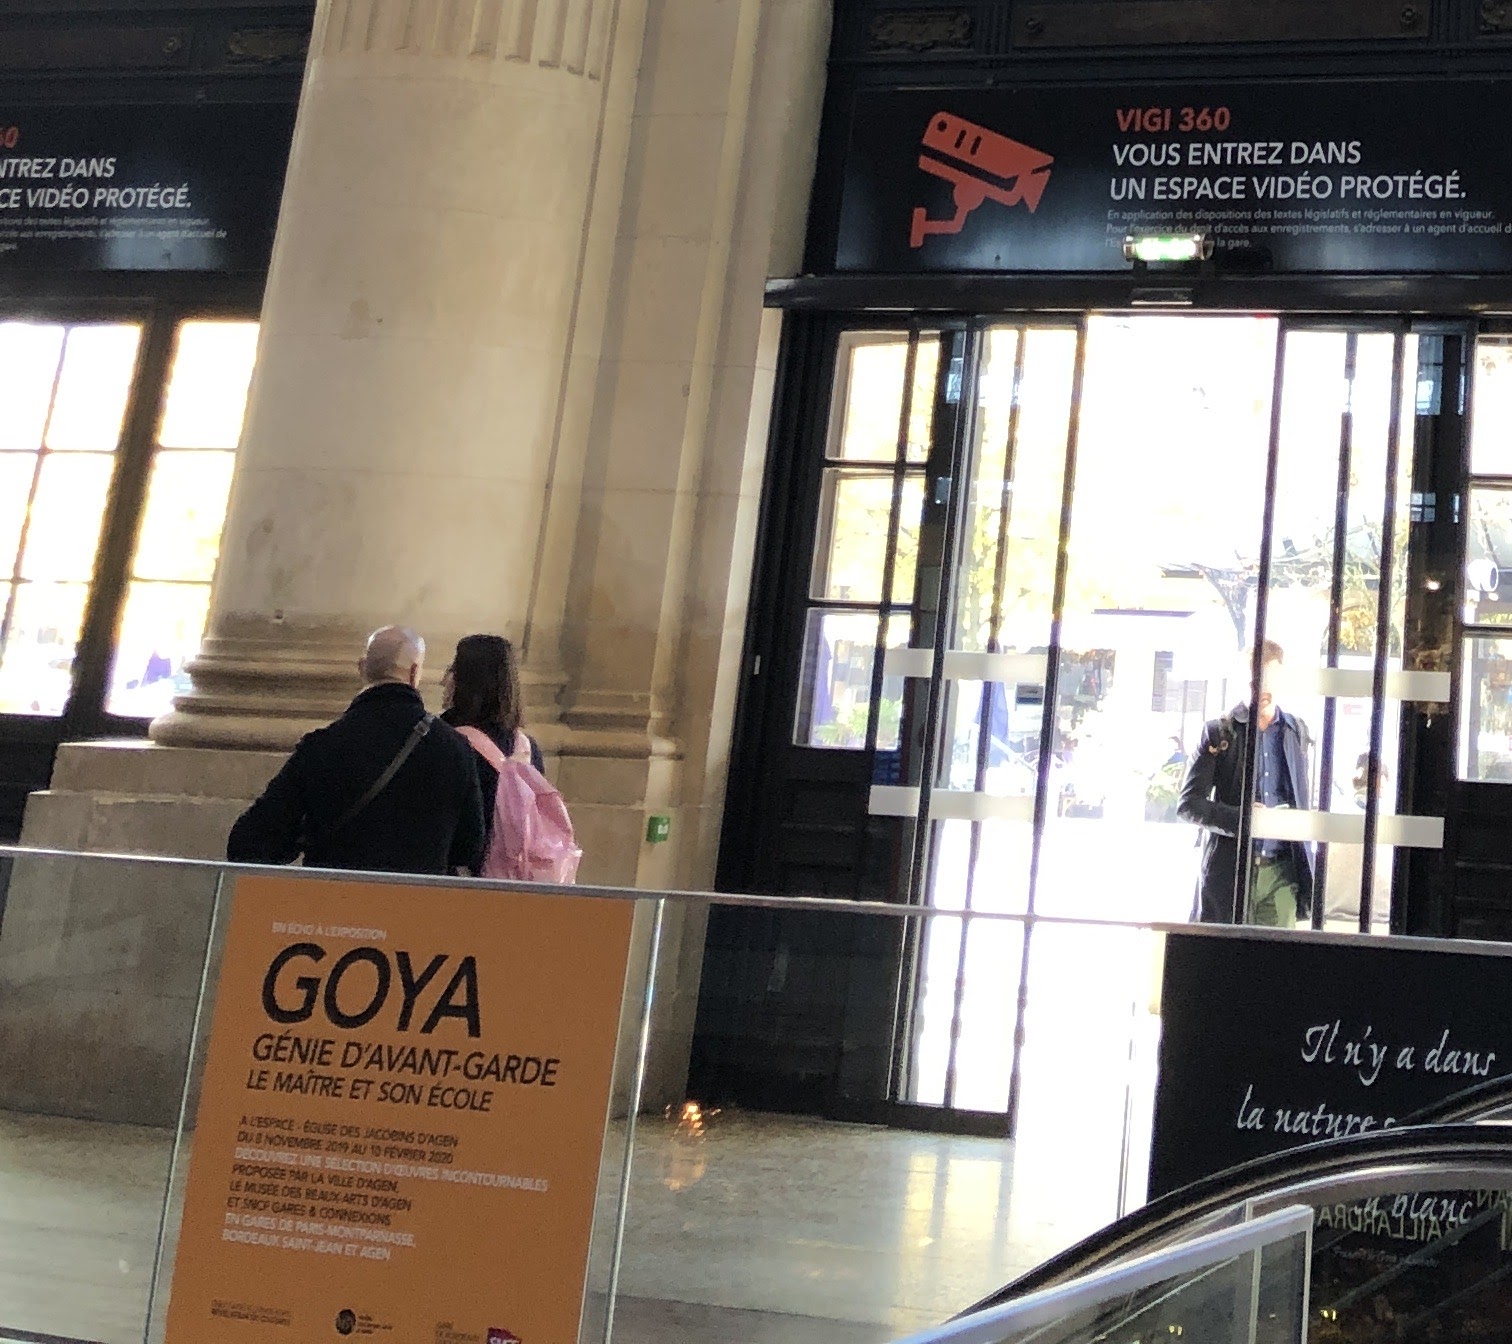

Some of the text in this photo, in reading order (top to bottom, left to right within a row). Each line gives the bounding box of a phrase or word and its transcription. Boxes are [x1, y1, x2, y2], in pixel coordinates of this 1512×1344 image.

[1116, 107, 1231, 132] VIGI 360
[0, 157, 117, 178] NTREZ DANS
[1113, 140, 1362, 166] VOUS ENTREZ DANS
[26, 183, 89, 208] VIDÉO
[93, 182, 192, 209] PROTÉGÉ.
[1110, 169, 1467, 201] UN ESPACE VIDÉO PROTÉGÉ.
[1107, 209, 1119, 219] En
[1121, 209, 1173, 223] application
[1176, 209, 1192, 219] des
[1254, 209, 1271, 219] des
[261, 941, 481, 1038] GOYA
[252, 1028, 561, 1087] GÉNIE D'AVANT-GARDE
[1344, 1025, 1388, 1086] n'y
[1396, 1046, 1416, 1070] a
[1424, 1029, 1496, 1076] dans
[246, 1068, 494, 1113] LE MAÎTRE ET SON ÉCOLE
[1236, 1084, 1377, 1137] la nature
